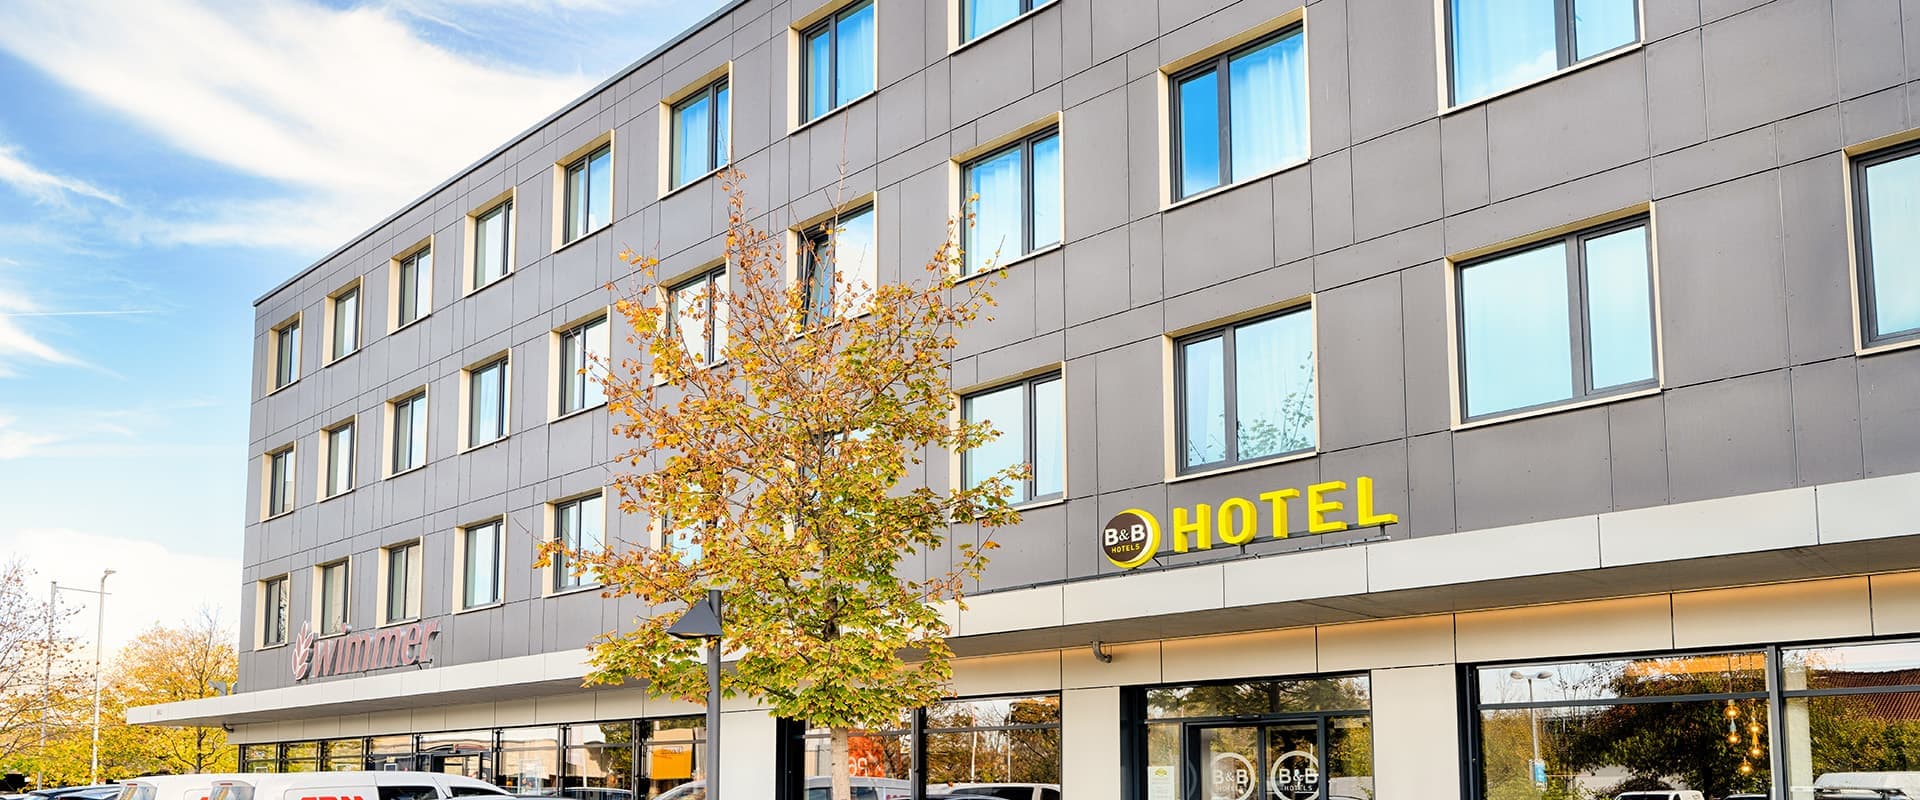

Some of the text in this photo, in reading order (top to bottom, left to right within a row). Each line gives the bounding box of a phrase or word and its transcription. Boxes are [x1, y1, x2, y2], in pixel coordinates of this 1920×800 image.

[1173, 476, 1399, 553] HOTEL
[1104, 524, 1146, 546] B&B
[1111, 543, 1141, 553] HOTELS
[313, 620, 441, 678] wimmer
[1213, 768, 1249, 785] B&B
[1279, 767, 1318, 784] B&B
